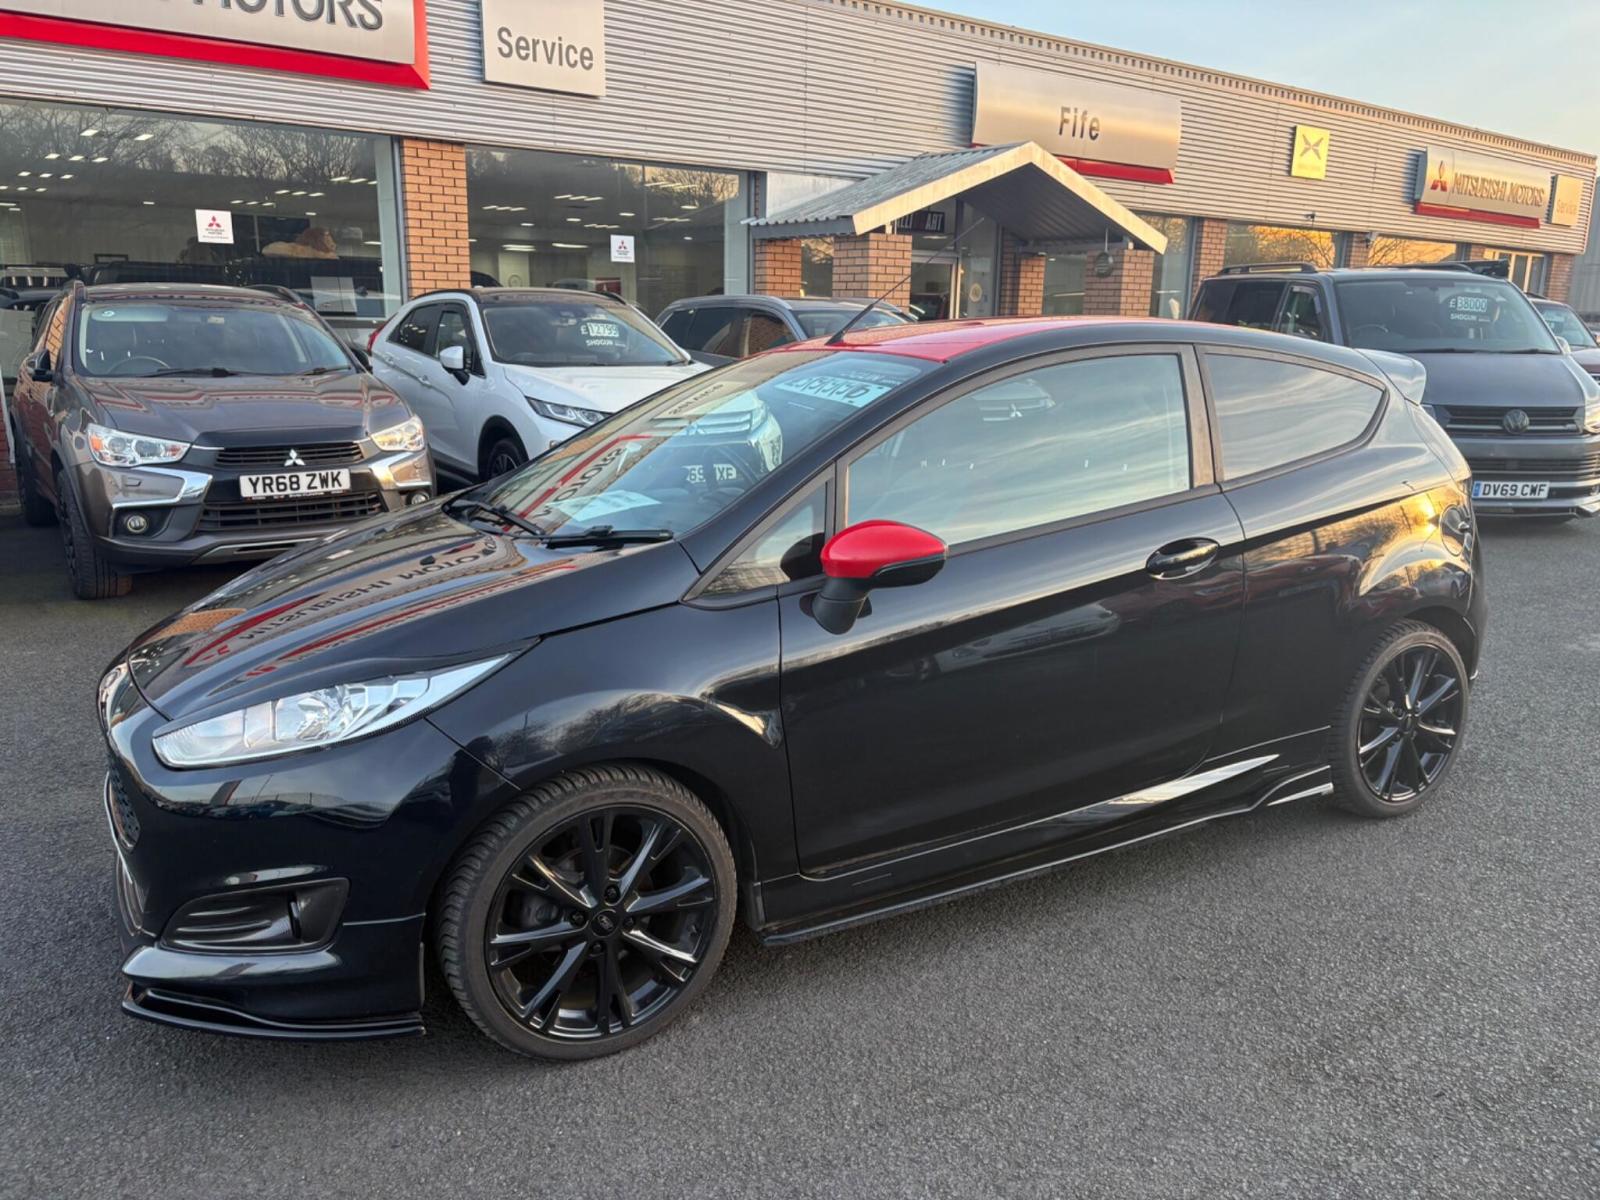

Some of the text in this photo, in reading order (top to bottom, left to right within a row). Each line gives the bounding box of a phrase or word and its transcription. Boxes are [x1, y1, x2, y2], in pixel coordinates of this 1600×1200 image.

[497, 26, 594, 71] Service
[1058, 106, 1100, 141] Fife
[1451, 173, 1545, 208] MITSUBISHI MOTORS
[248, 471, 342, 494] YR68 ZWK
[1482, 483, 1547, 496] DV69 CWF
